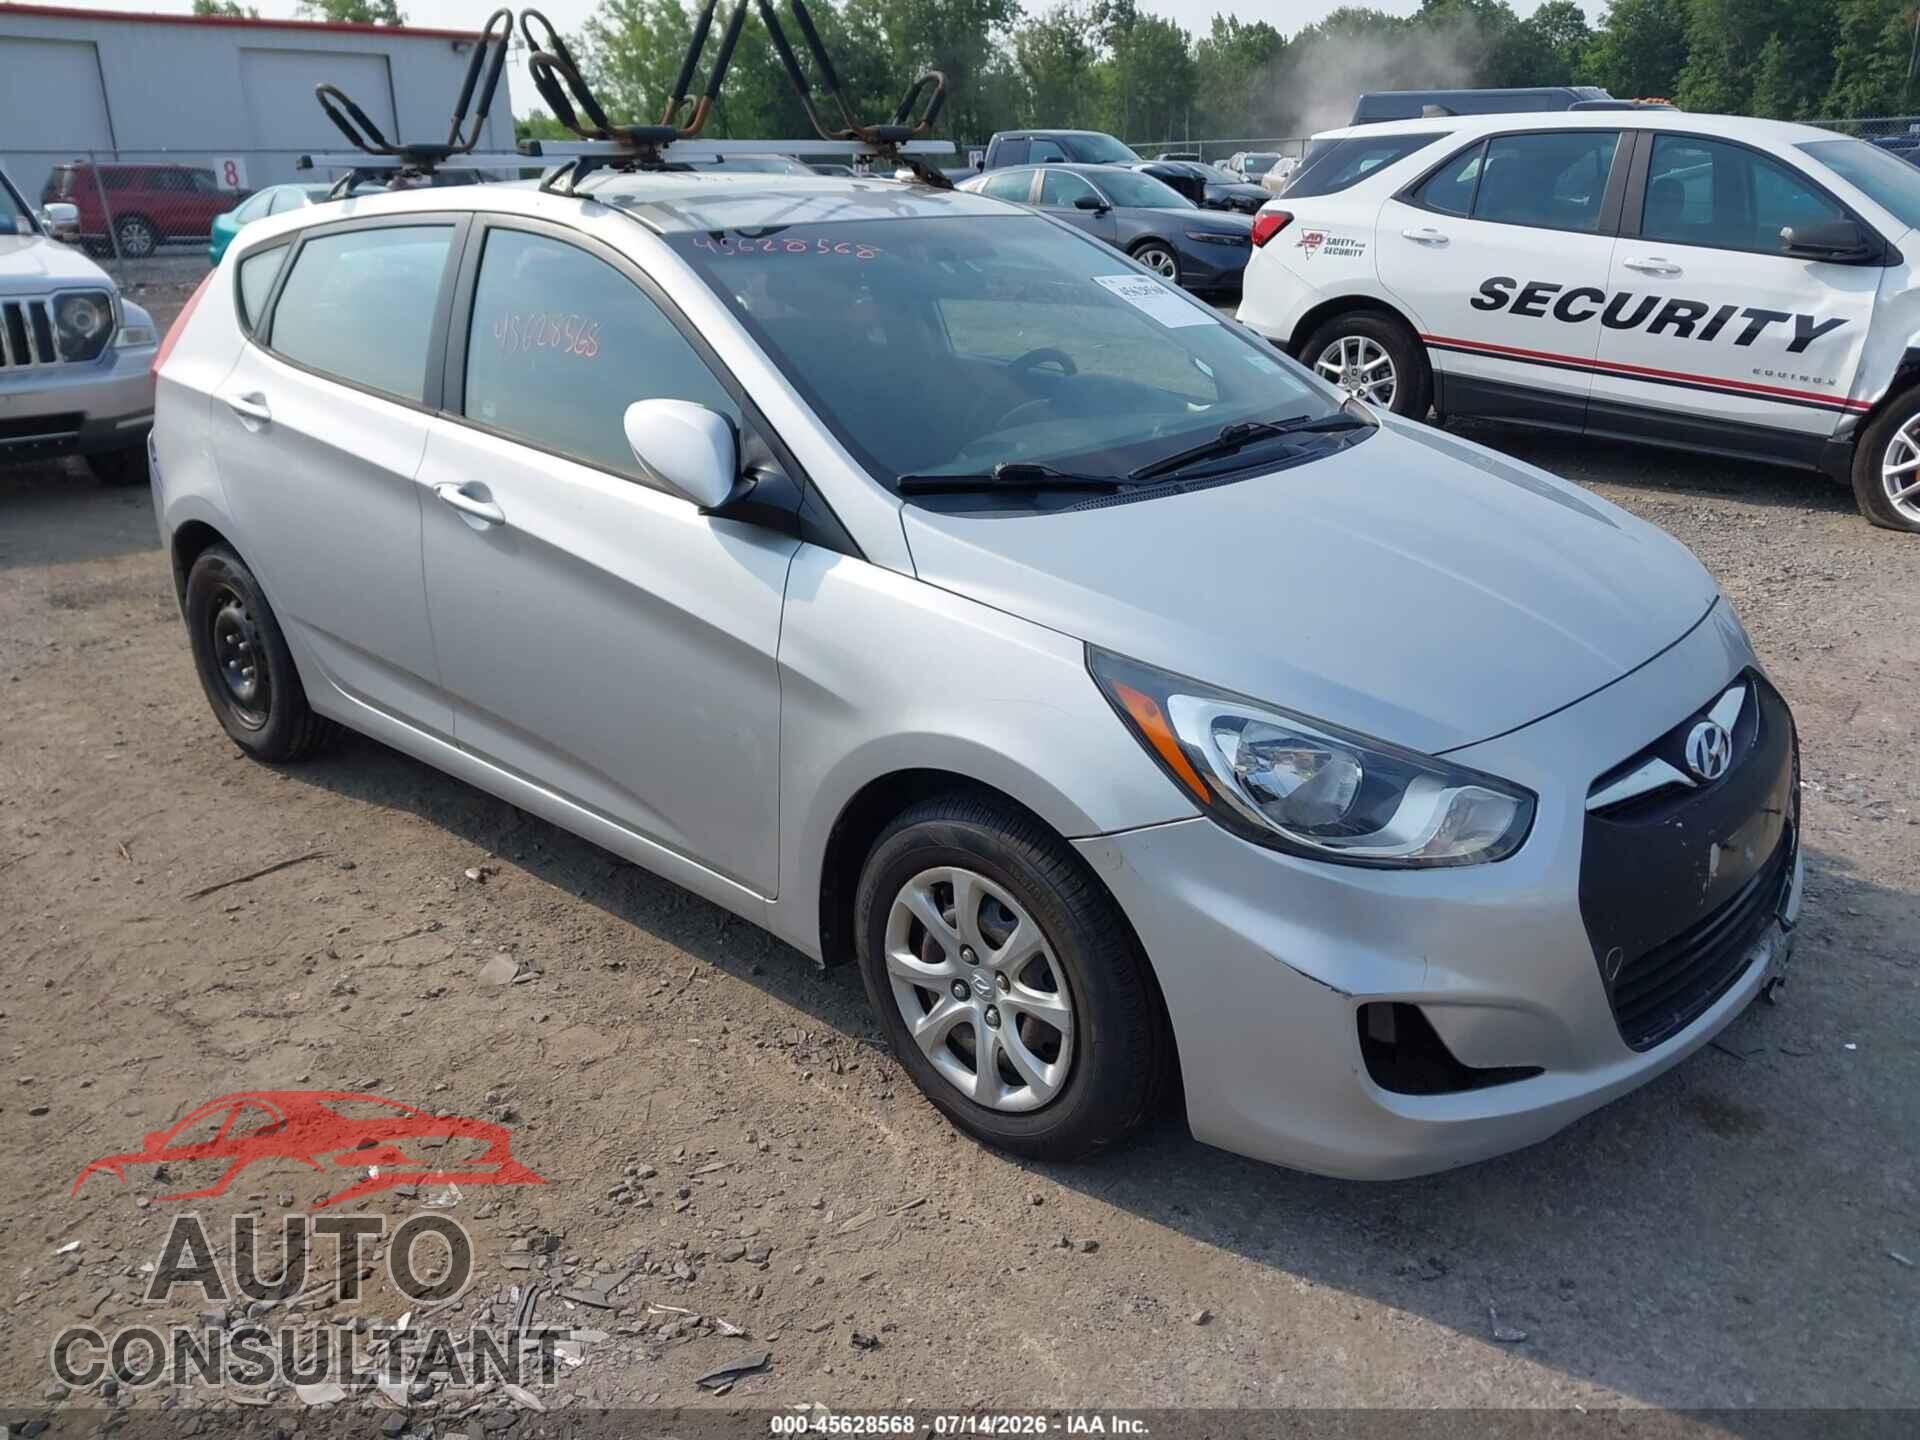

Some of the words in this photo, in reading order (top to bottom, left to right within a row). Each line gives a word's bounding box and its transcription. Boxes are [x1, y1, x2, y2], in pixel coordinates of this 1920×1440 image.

[224, 160, 239, 186] 8
[1326, 237, 1356, 247] SAFETY
[1323, 247, 1364, 257] SECURITY
[1470, 276, 1849, 353] SECURITY
[1752, 367, 1837, 386] EQUINOX
